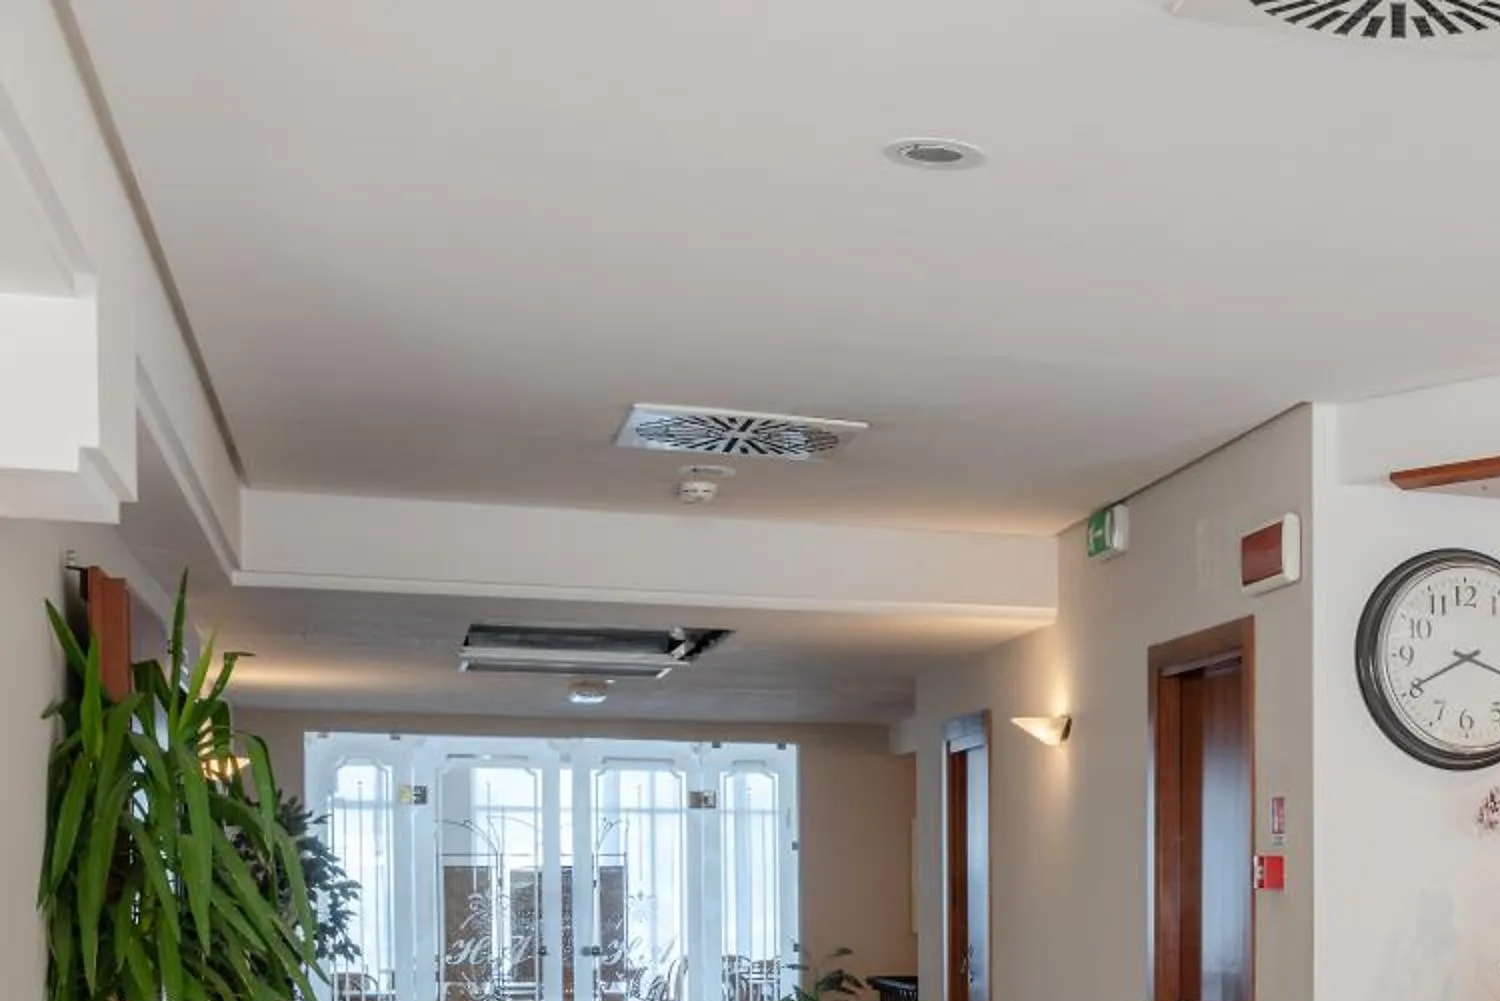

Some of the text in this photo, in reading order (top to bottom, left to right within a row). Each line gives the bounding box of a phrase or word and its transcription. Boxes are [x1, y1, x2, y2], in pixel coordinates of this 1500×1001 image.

[1430, 594, 1446, 615] 11
[1455, 585, 1477, 608] 12
[1491, 595, 1497, 615] 1
[1409, 619, 1432, 640] 10
[1399, 645, 1414, 666] 9
[1409, 678, 1424, 699] 8
[1434, 700, 1447, 721] 7
[1459, 709, 1475, 730] 6
